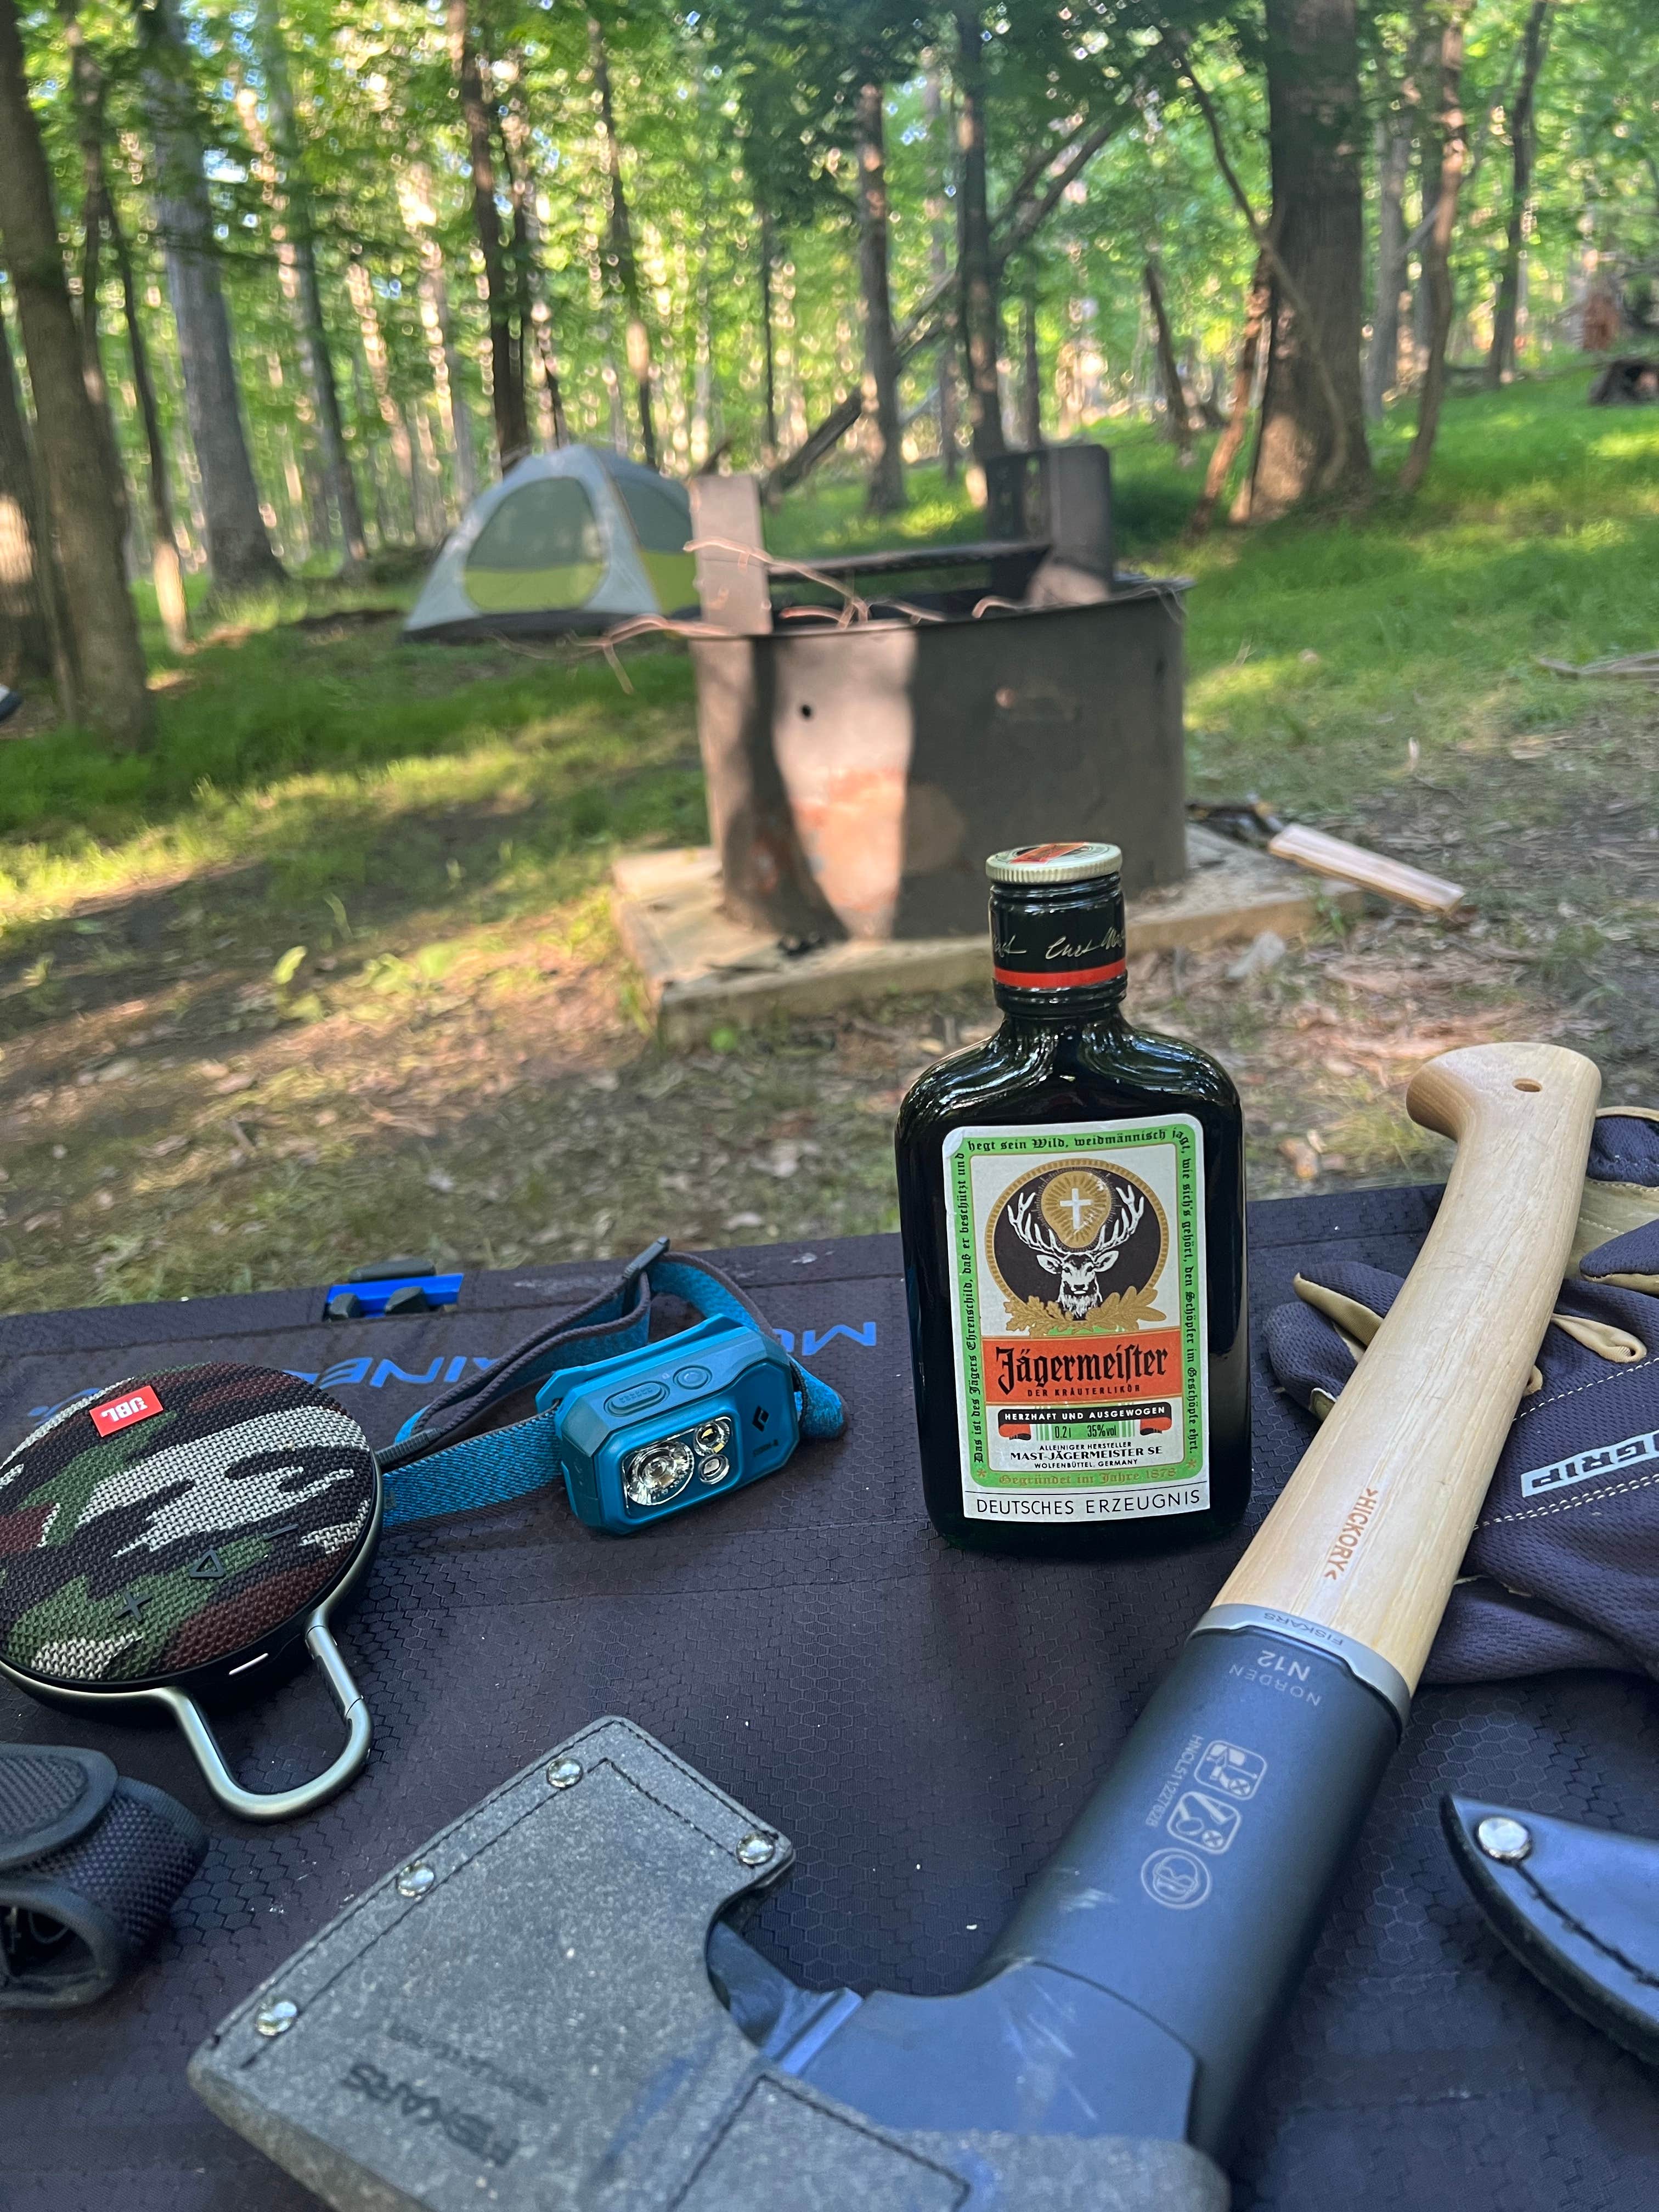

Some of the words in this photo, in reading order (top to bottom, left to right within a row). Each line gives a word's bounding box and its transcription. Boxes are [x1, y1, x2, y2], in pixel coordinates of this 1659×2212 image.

[968, 1140, 995, 1152] hegt
[1001, 1141, 1026, 1150] sein
[1032, 1138, 1069, 1149] Wild,
[1074, 1129, 1167, 1147] weidmännisch
[956, 1153, 966, 1175] und
[958, 1186, 970, 1233] beschützt
[963, 1238, 971, 1250] er
[1185, 1265, 1194, 1286] den
[1185, 1291, 1196, 1344] Schöpfer
[1186, 1348, 1195, 1363] im
[969, 1355, 981, 1395] Jägers
[1054, 1384, 1141, 1396] KRÄUTERLIKÖR
[1186, 1367, 1199, 1426] Geschöpfe
[100, 1396, 148, 1422] JBL
[971, 1400, 980, 1418] des
[1004, 1411, 1057, 1420] HERZHAFT
[1062, 1410, 1084, 1420] UND
[1088, 1406, 1165, 1419] AUSGEWOGEN
[972, 1421, 981, 1435] ist
[974, 1440, 983, 1463] Das
[1010, 1447, 1144, 1461] MAST-JÄGERMEISTER
[1147, 1446, 1163, 1455] SE
[1087, 1441, 1131, 1449] HERSTELLER
[1098, 1458, 1138, 1468] GERMANY
[998, 1475, 1072, 1487] Gegründet
[1076, 1473, 1094, 1484] im
[1102, 1471, 1139, 1485] Jahre
[1145, 1468, 1177, 1480] 1878
[976, 1498, 1074, 1515] DEUTSCHES
[1086, 1489, 1200, 1514] ERZEUGNIS
[1263, 1612, 1344, 1646] FISKARS
[1256, 1649, 1312, 1681] N12
[1228, 1663, 1322, 1706] NORDEN
